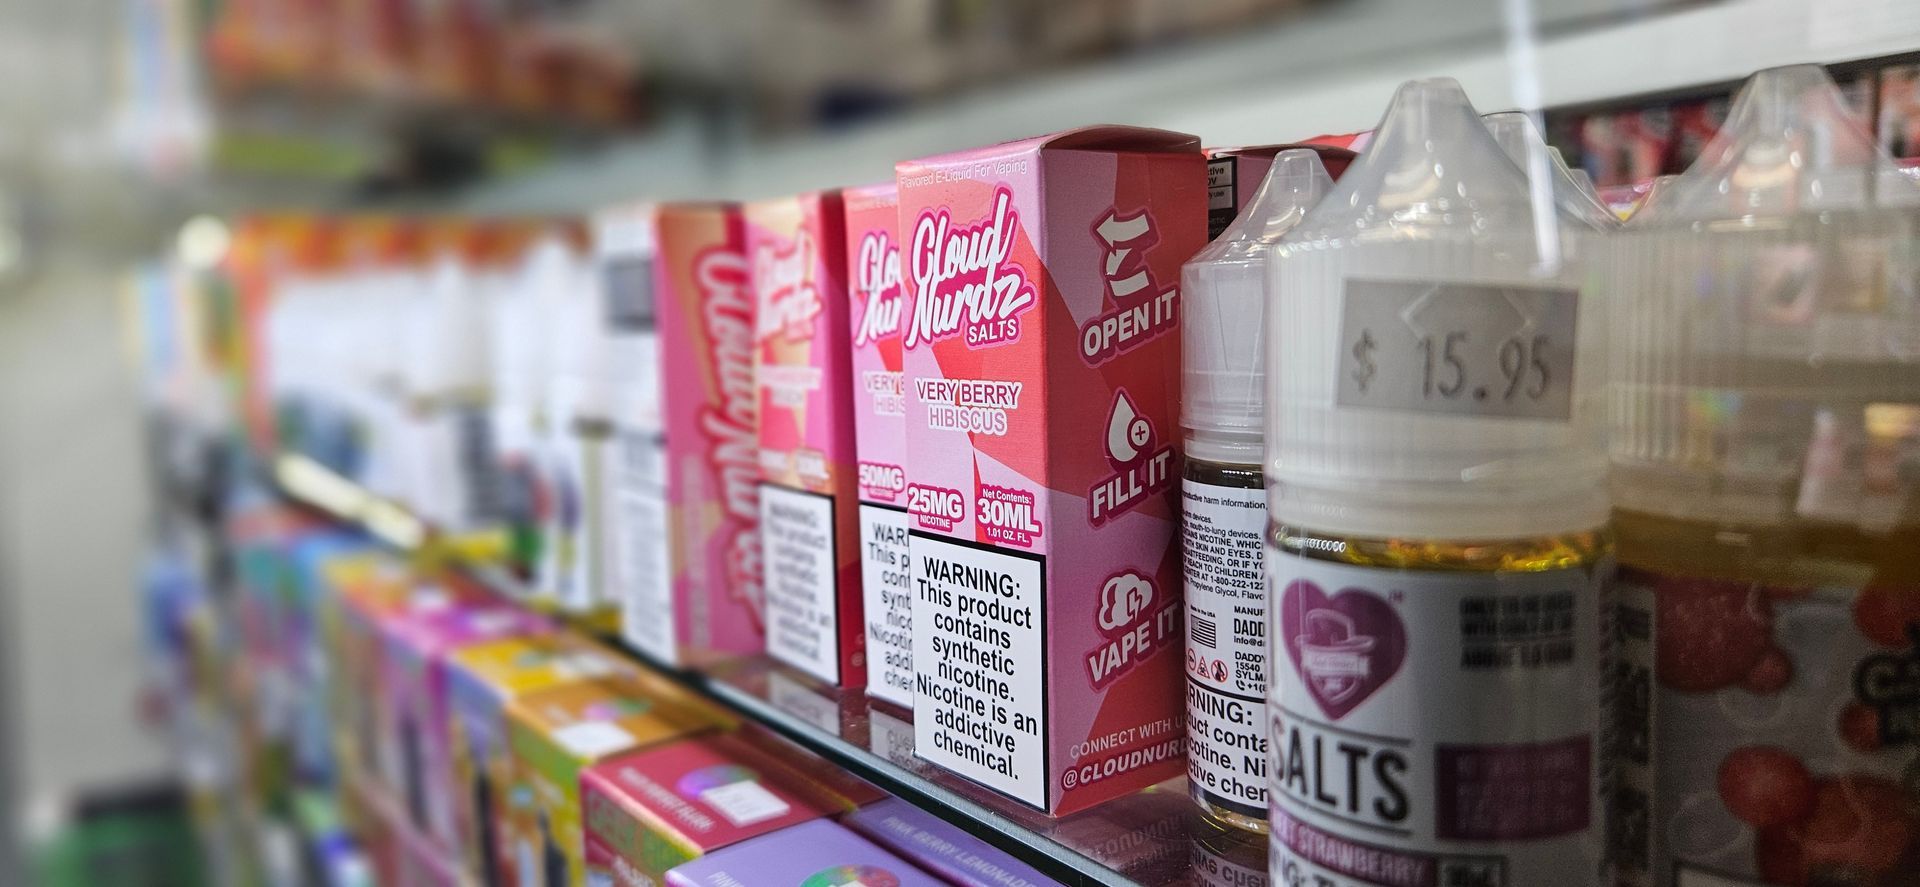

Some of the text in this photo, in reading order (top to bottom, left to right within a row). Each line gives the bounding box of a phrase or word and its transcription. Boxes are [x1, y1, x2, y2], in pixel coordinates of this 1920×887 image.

[900, 158, 1028, 190] Flavored E-Liquid For Vaping
[913, 192, 1015, 286] Cloud
[859, 234, 900, 291] Clo
[905, 268, 1032, 347] Nurdz
[1084, 289, 1176, 357] OPEN IT
[968, 318, 1017, 343] SALTS
[1417, 331, 1550, 400] 15.95
[917, 381, 957, 402] VERY
[961, 383, 1020, 406] BERRY
[929, 406, 1006, 433] HIBISCUS
[859, 464, 904, 491] 50MG
[1093, 449, 1170, 519] FILL IT
[908, 486, 963, 518] 25MG
[982, 488, 1032, 505] Net Contents:
[919, 514, 951, 529] NICOTINE
[978, 498, 1039, 534] 30ML
[987, 526, 1030, 544] 1.01 OZ. FL.
[1196, 540, 1209, 553] SKIN
[1210, 544, 1226, 556] AND
[1227, 549, 1255, 560] EYES.
[1199, 534, 1235, 548] NICOTINE,
[1236, 541, 1264, 550] WHIC
[1228, 528, 1261, 540] devices.
[868, 542, 896, 566] This
[1226, 558, 1241, 568] OR
[924, 556, 1021, 600] WARNING:
[1204, 563, 1213, 573] TO
[1214, 565, 1258, 580] CHILDREN
[917, 578, 1032, 630] This product
[1214, 586, 1240, 599] Glycol,
[934, 612, 1012, 649] contains
[1089, 602, 1179, 683] VAPE IT
[932, 636, 1015, 676] synthetic
[1235, 661, 1260, 673] 15540
[938, 660, 1015, 702] nicotine.
[1235, 669, 1266, 682] SYLM
[917, 672, 1038, 736] Nicotine is an
[1187, 687, 1253, 727] RNING:
[935, 708, 1016, 753] addictive
[1070, 728, 1136, 759] CONNECT
[1138, 716, 1171, 738] WITH
[934, 729, 1019, 780] chemical.
[1271, 715, 1410, 823] SALTS
[914, 831, 956, 856] BERRY
